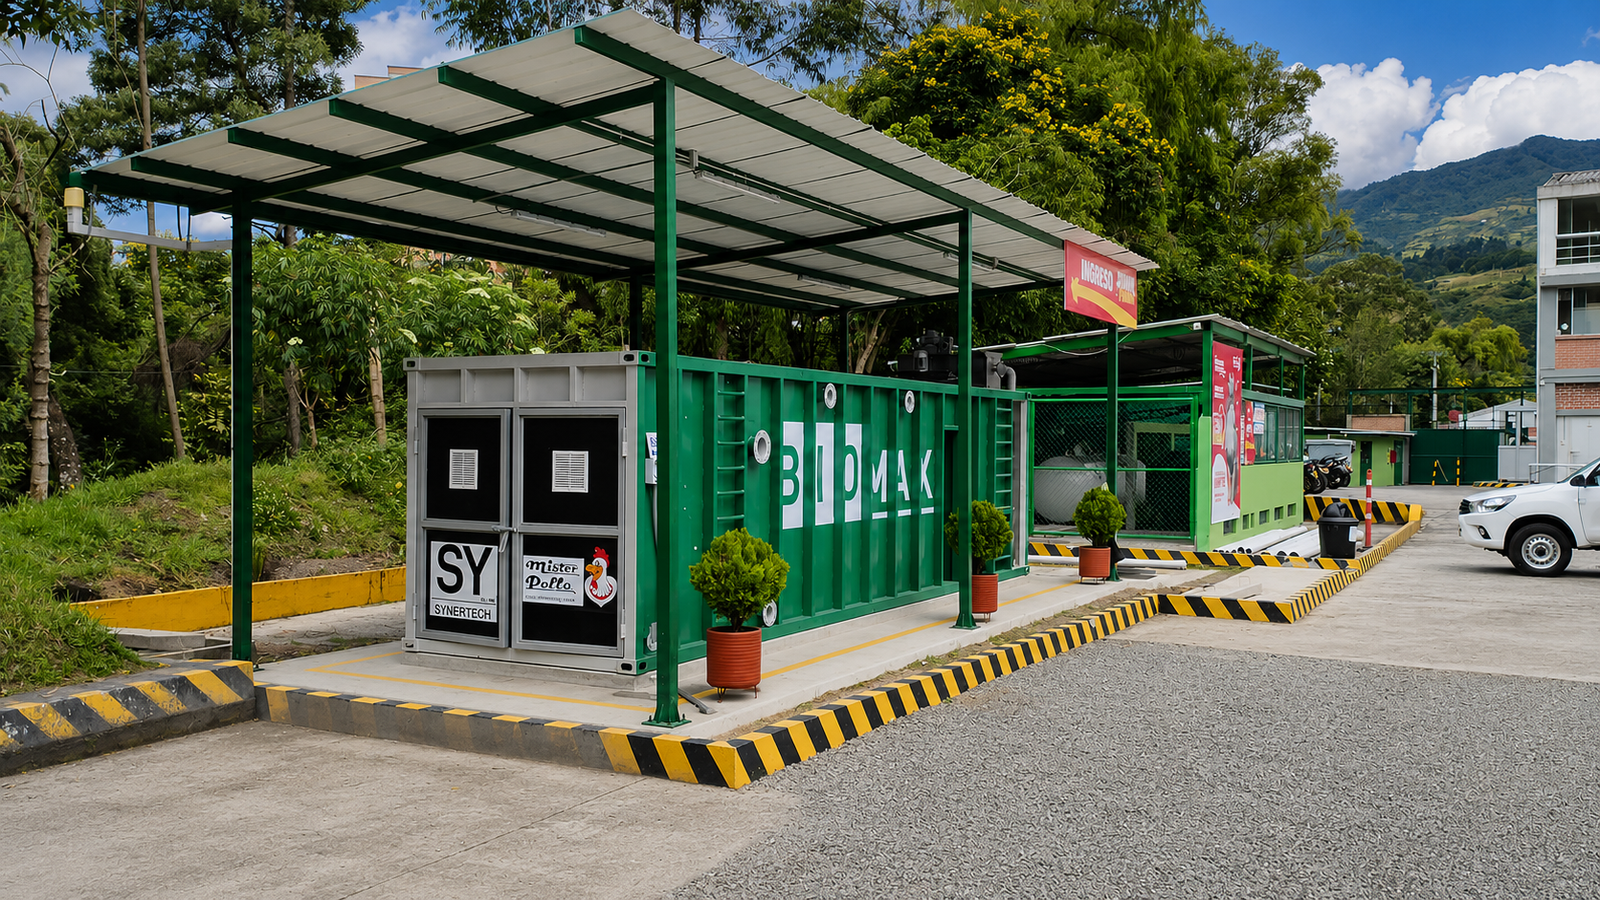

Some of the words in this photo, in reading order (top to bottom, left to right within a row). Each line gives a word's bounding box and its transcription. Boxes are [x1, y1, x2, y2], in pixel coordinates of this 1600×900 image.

[1081, 258, 1114, 292] INGRESO
[436, 543, 494, 596] SY
[525, 559, 579, 575] Mister
[525, 575, 572, 590] Pollo
[434, 603, 492, 620] SYNERTECH
